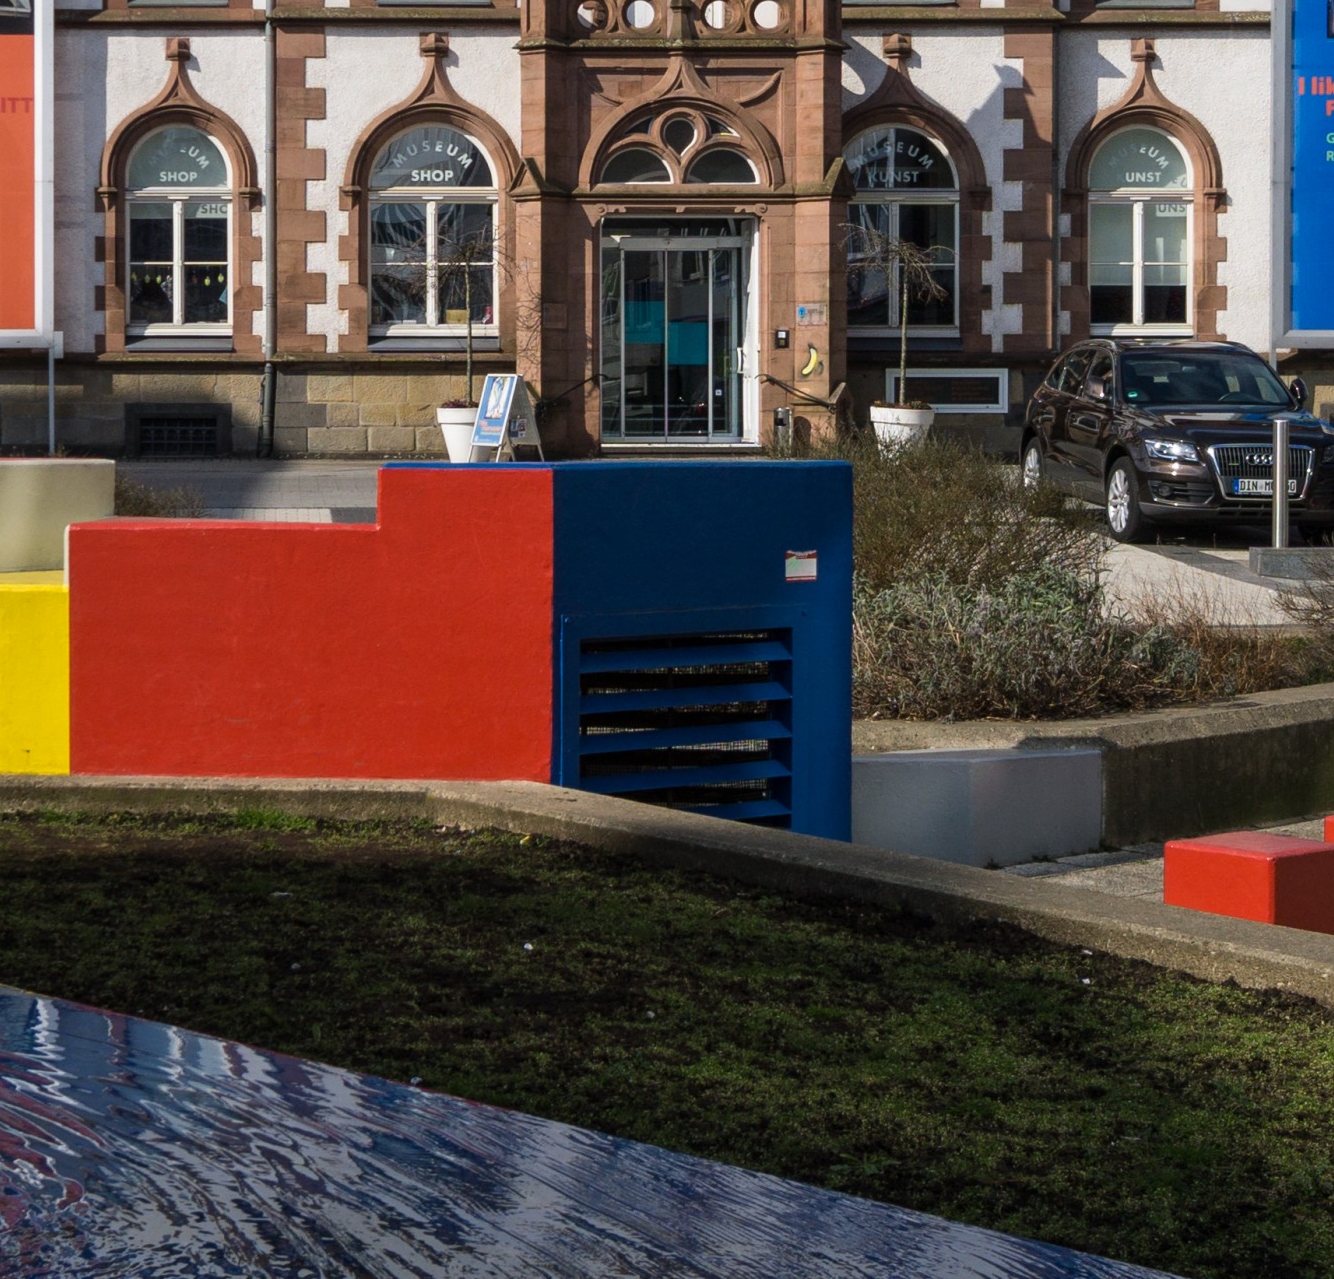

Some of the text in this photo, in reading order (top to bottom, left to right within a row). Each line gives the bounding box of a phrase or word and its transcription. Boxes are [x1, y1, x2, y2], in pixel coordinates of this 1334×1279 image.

[1298, 76, 1305, 95] I
[392, 140, 473, 169] MUSEUM
[159, 171, 198, 182] SHOP
[411, 169, 454, 182] SHOP
[869, 171, 919, 183] KUNST
[1240, 481, 1258, 491] DIN
